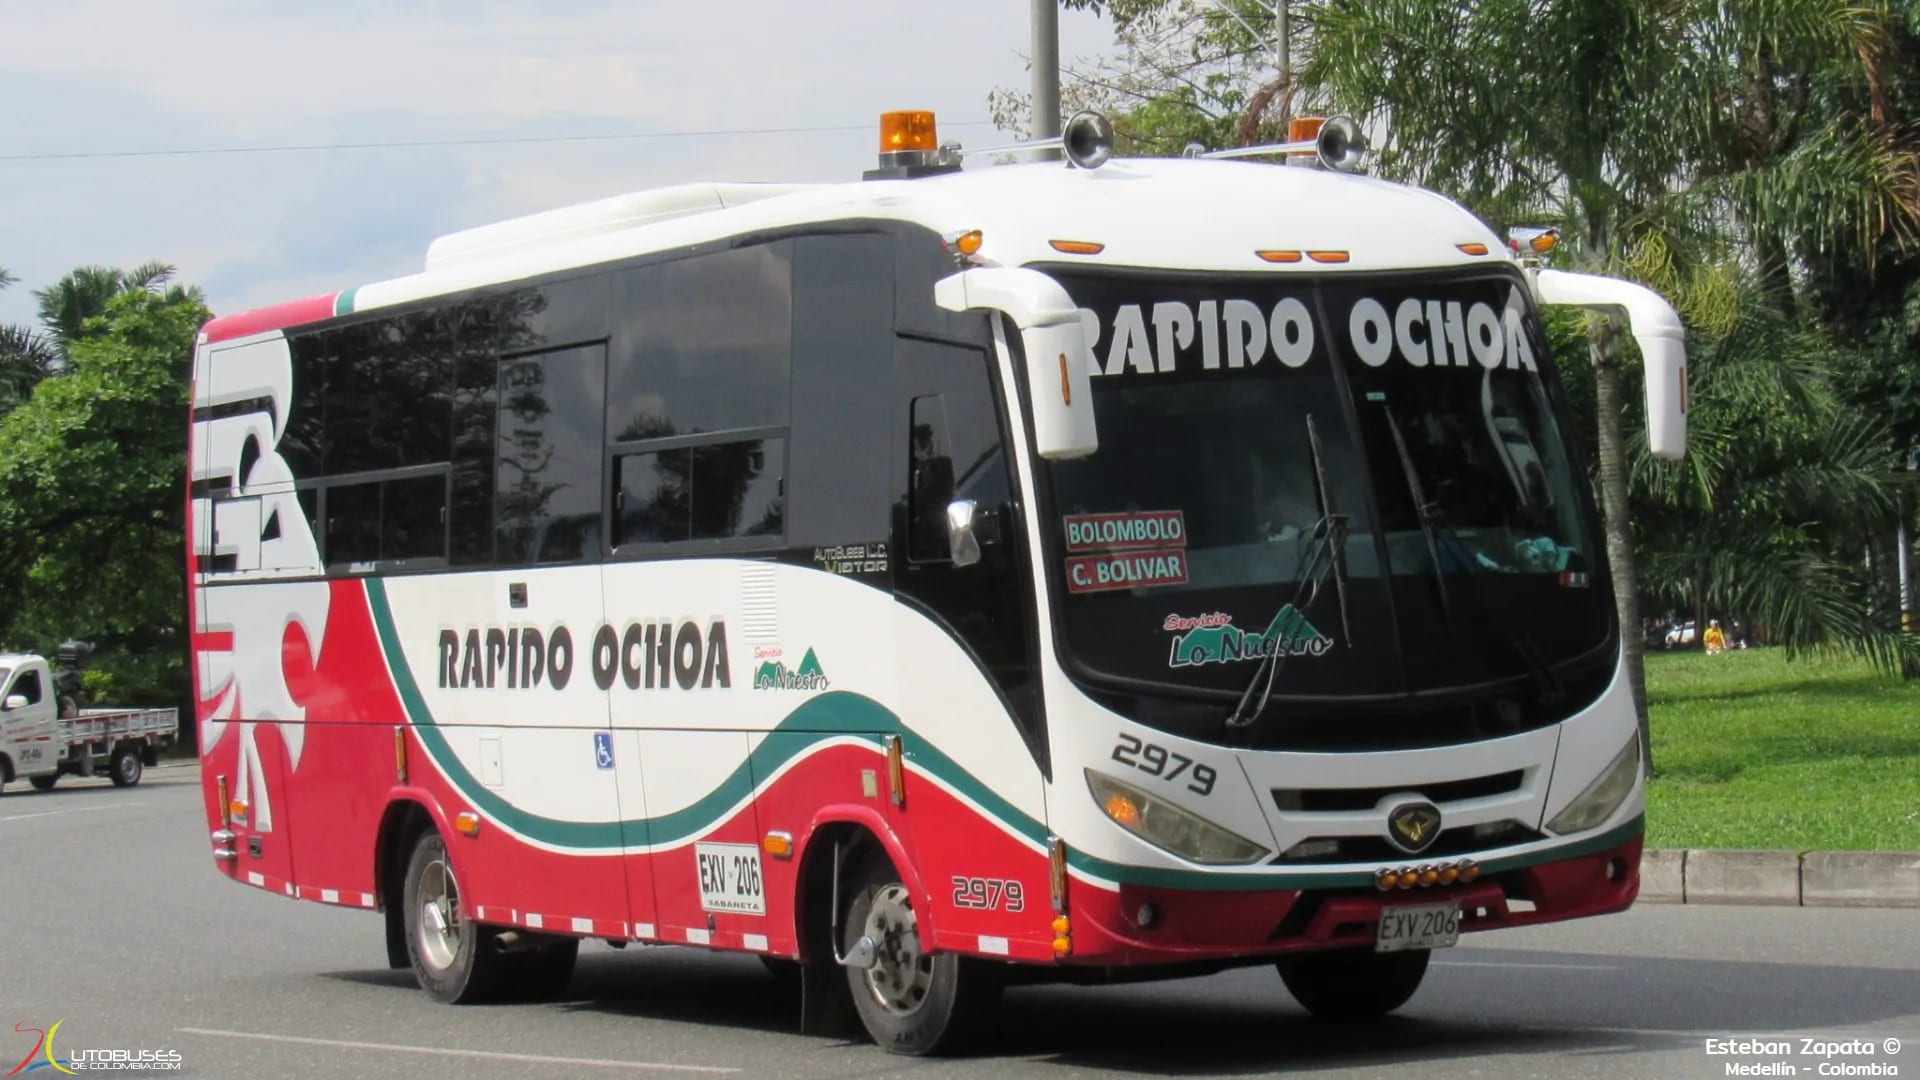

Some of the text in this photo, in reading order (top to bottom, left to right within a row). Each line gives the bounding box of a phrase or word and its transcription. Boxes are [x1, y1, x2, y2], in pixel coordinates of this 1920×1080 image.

[1349, 297, 1539, 373] OCHOA
[1068, 517, 1181, 545] BOLOMBOLO
[1072, 555, 1182, 586] C. BOLIVAR
[1163, 611, 1233, 631] Servicio
[438, 619, 732, 691] RAPIDO OCHOA
[1169, 629, 1334, 669] Lo Nuestro
[753, 664, 831, 691] Lo Nuestro
[1111, 732, 1217, 796] 2979
[699, 853, 760, 897] EXV 206
[708, 899, 760, 911] SABANETA
[951, 875, 1025, 913] 2979
[1381, 908, 1456, 940] EXV 206
